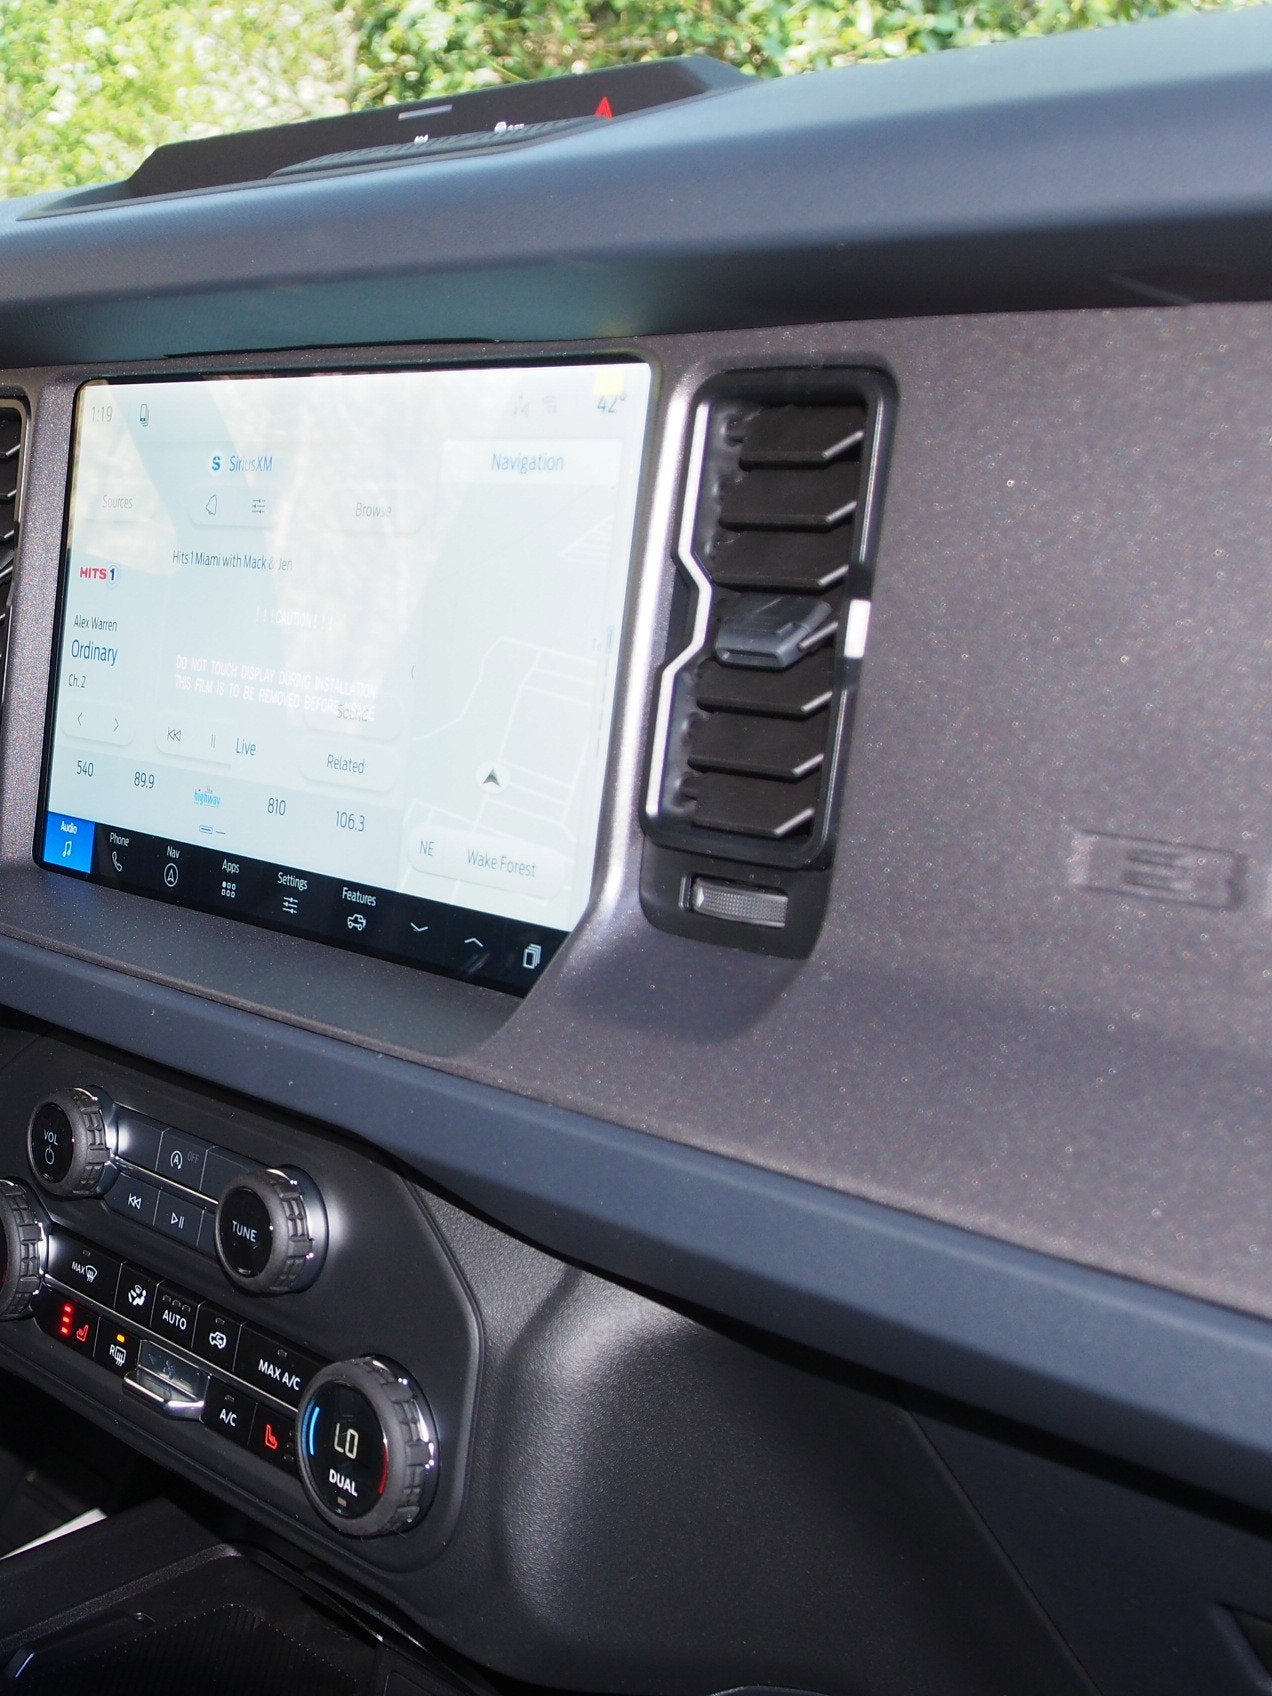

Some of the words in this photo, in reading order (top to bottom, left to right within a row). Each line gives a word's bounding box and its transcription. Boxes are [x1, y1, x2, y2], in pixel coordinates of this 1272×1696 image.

[91, 406, 113, 423] 1:19
[228, 455, 273, 472] SiriusXM
[491, 452, 565, 474] Navigation
[102, 494, 134, 509] Sources
[355, 501, 392, 517] Browse
[172, 550, 189, 564] Hits
[195, 551, 220, 567] Miami
[222, 553, 241, 568] with
[243, 555, 266, 570] Mack
[277, 556, 293, 571] Jen
[73, 614, 89, 629] Alex
[90, 616, 118, 632] Warren
[70, 639, 118, 666] Ordinary
[176, 654, 188, 670] DO
[191, 657, 208, 672] NOT
[211, 660, 238, 678] TOUCH
[241, 664, 276, 683] DISPLAY
[279, 669, 311, 690] DURING
[175, 674, 192, 690] THIS
[195, 677, 214, 693] FILM
[216, 680, 225, 696] IS
[229, 682, 240, 698] TO
[242, 685, 255, 701] BE
[258, 688, 300, 709] REMOVED
[235, 738, 257, 756] Live
[76, 760, 94, 777] 540
[326, 754, 365, 774] Related
[133, 771, 155, 789] 89.9
[267, 797, 287, 816] 810
[60, 820, 78, 835] Audio
[335, 810, 365, 832] 106.3
[109, 831, 130, 847] Phone
[419, 839, 435, 857] NE
[166, 845, 180, 859] Nav
[221, 858, 240, 874] Apps
[466, 848, 497, 870] Wake
[499, 856, 536, 878] Forest
[277, 871, 308, 892] Settings
[342, 886, 377, 907] Features
[43, 1128, 59, 1146] VOL
[231, 1219, 258, 1243] TUNE
[71, 1260, 86, 1276] MAX
[162, 1308, 187, 1332] AUTO
[258, 1358, 281, 1382] MAX
[281, 1370, 301, 1392] A/C
[219, 1408, 237, 1428] A/C
[333, 1428, 358, 1460] LO
[329, 1468, 358, 1498] DUAL
